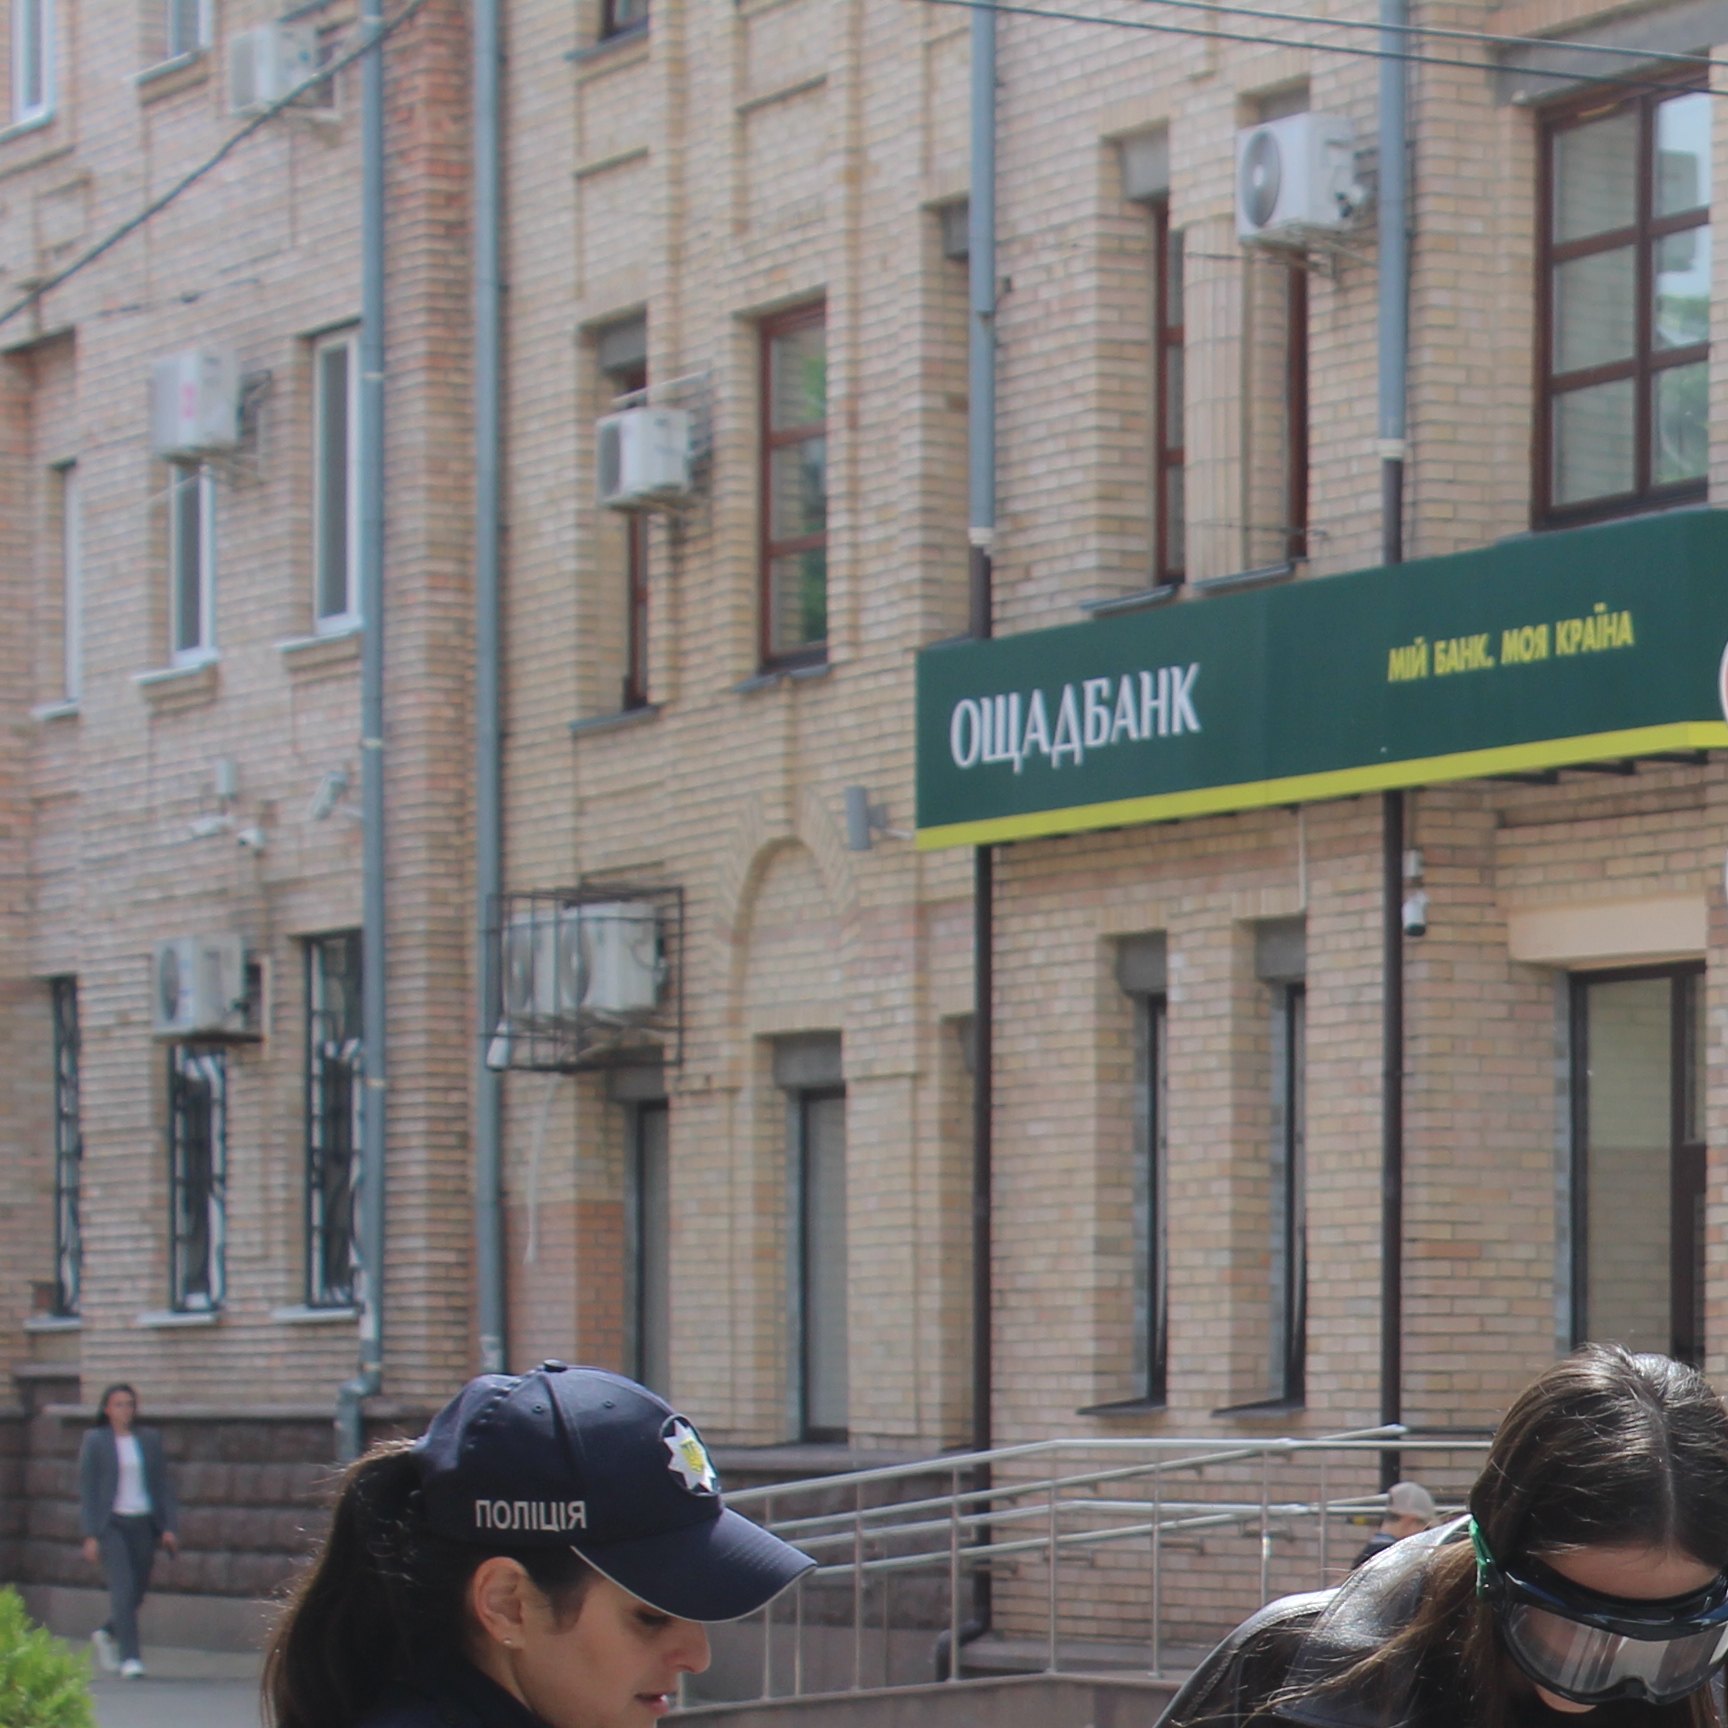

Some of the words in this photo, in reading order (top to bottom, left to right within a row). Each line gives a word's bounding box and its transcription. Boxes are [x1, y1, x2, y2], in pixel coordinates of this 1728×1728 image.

[1387, 635, 1430, 682] МІЙ
[1433, 632, 1495, 676] БАНК.
[1500, 623, 1549, 665] МОЯ
[1554, 602, 1635, 656] КРАЇНА
[950, 662, 1201, 775] ОЩАДБАНК
[475, 1499, 588, 1532] ПОЛІЦІЯ
